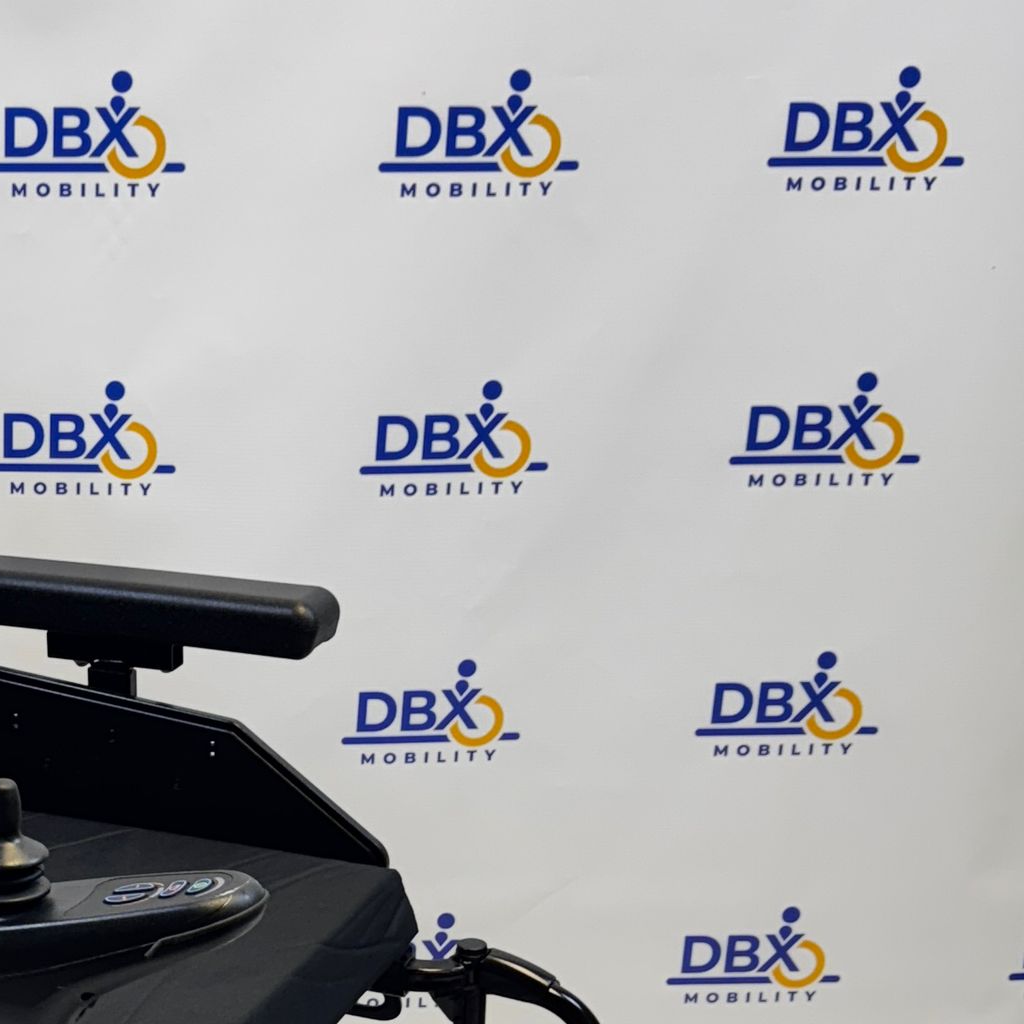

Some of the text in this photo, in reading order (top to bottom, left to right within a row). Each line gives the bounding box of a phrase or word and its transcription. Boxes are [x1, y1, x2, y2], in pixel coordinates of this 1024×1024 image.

[4, 107, 136, 158] DBX
[394, 105, 538, 158] DBX
[783, 101, 926, 153] DBX
[11, 183, 159, 198] MOBILITY
[400, 181, 554, 198] MOBILITY
[786, 176, 938, 192] MOBILITY
[3, 413, 132, 460] DBX
[374, 412, 509, 461] DBX
[745, 404, 883, 452] DBX
[10, 481, 151, 496] MOBILITY
[379, 481, 524, 497] MOBILITY
[747, 472, 895, 488] MOBILITY
[356, 689, 482, 734] DBX
[710, 680, 844, 726] DBX
[360, 749, 497, 766] MOBILITY
[713, 742, 854, 758] MOBILITY
[680, 934, 806, 973] DBX
[684, 989, 817, 1005] MOBILITY
